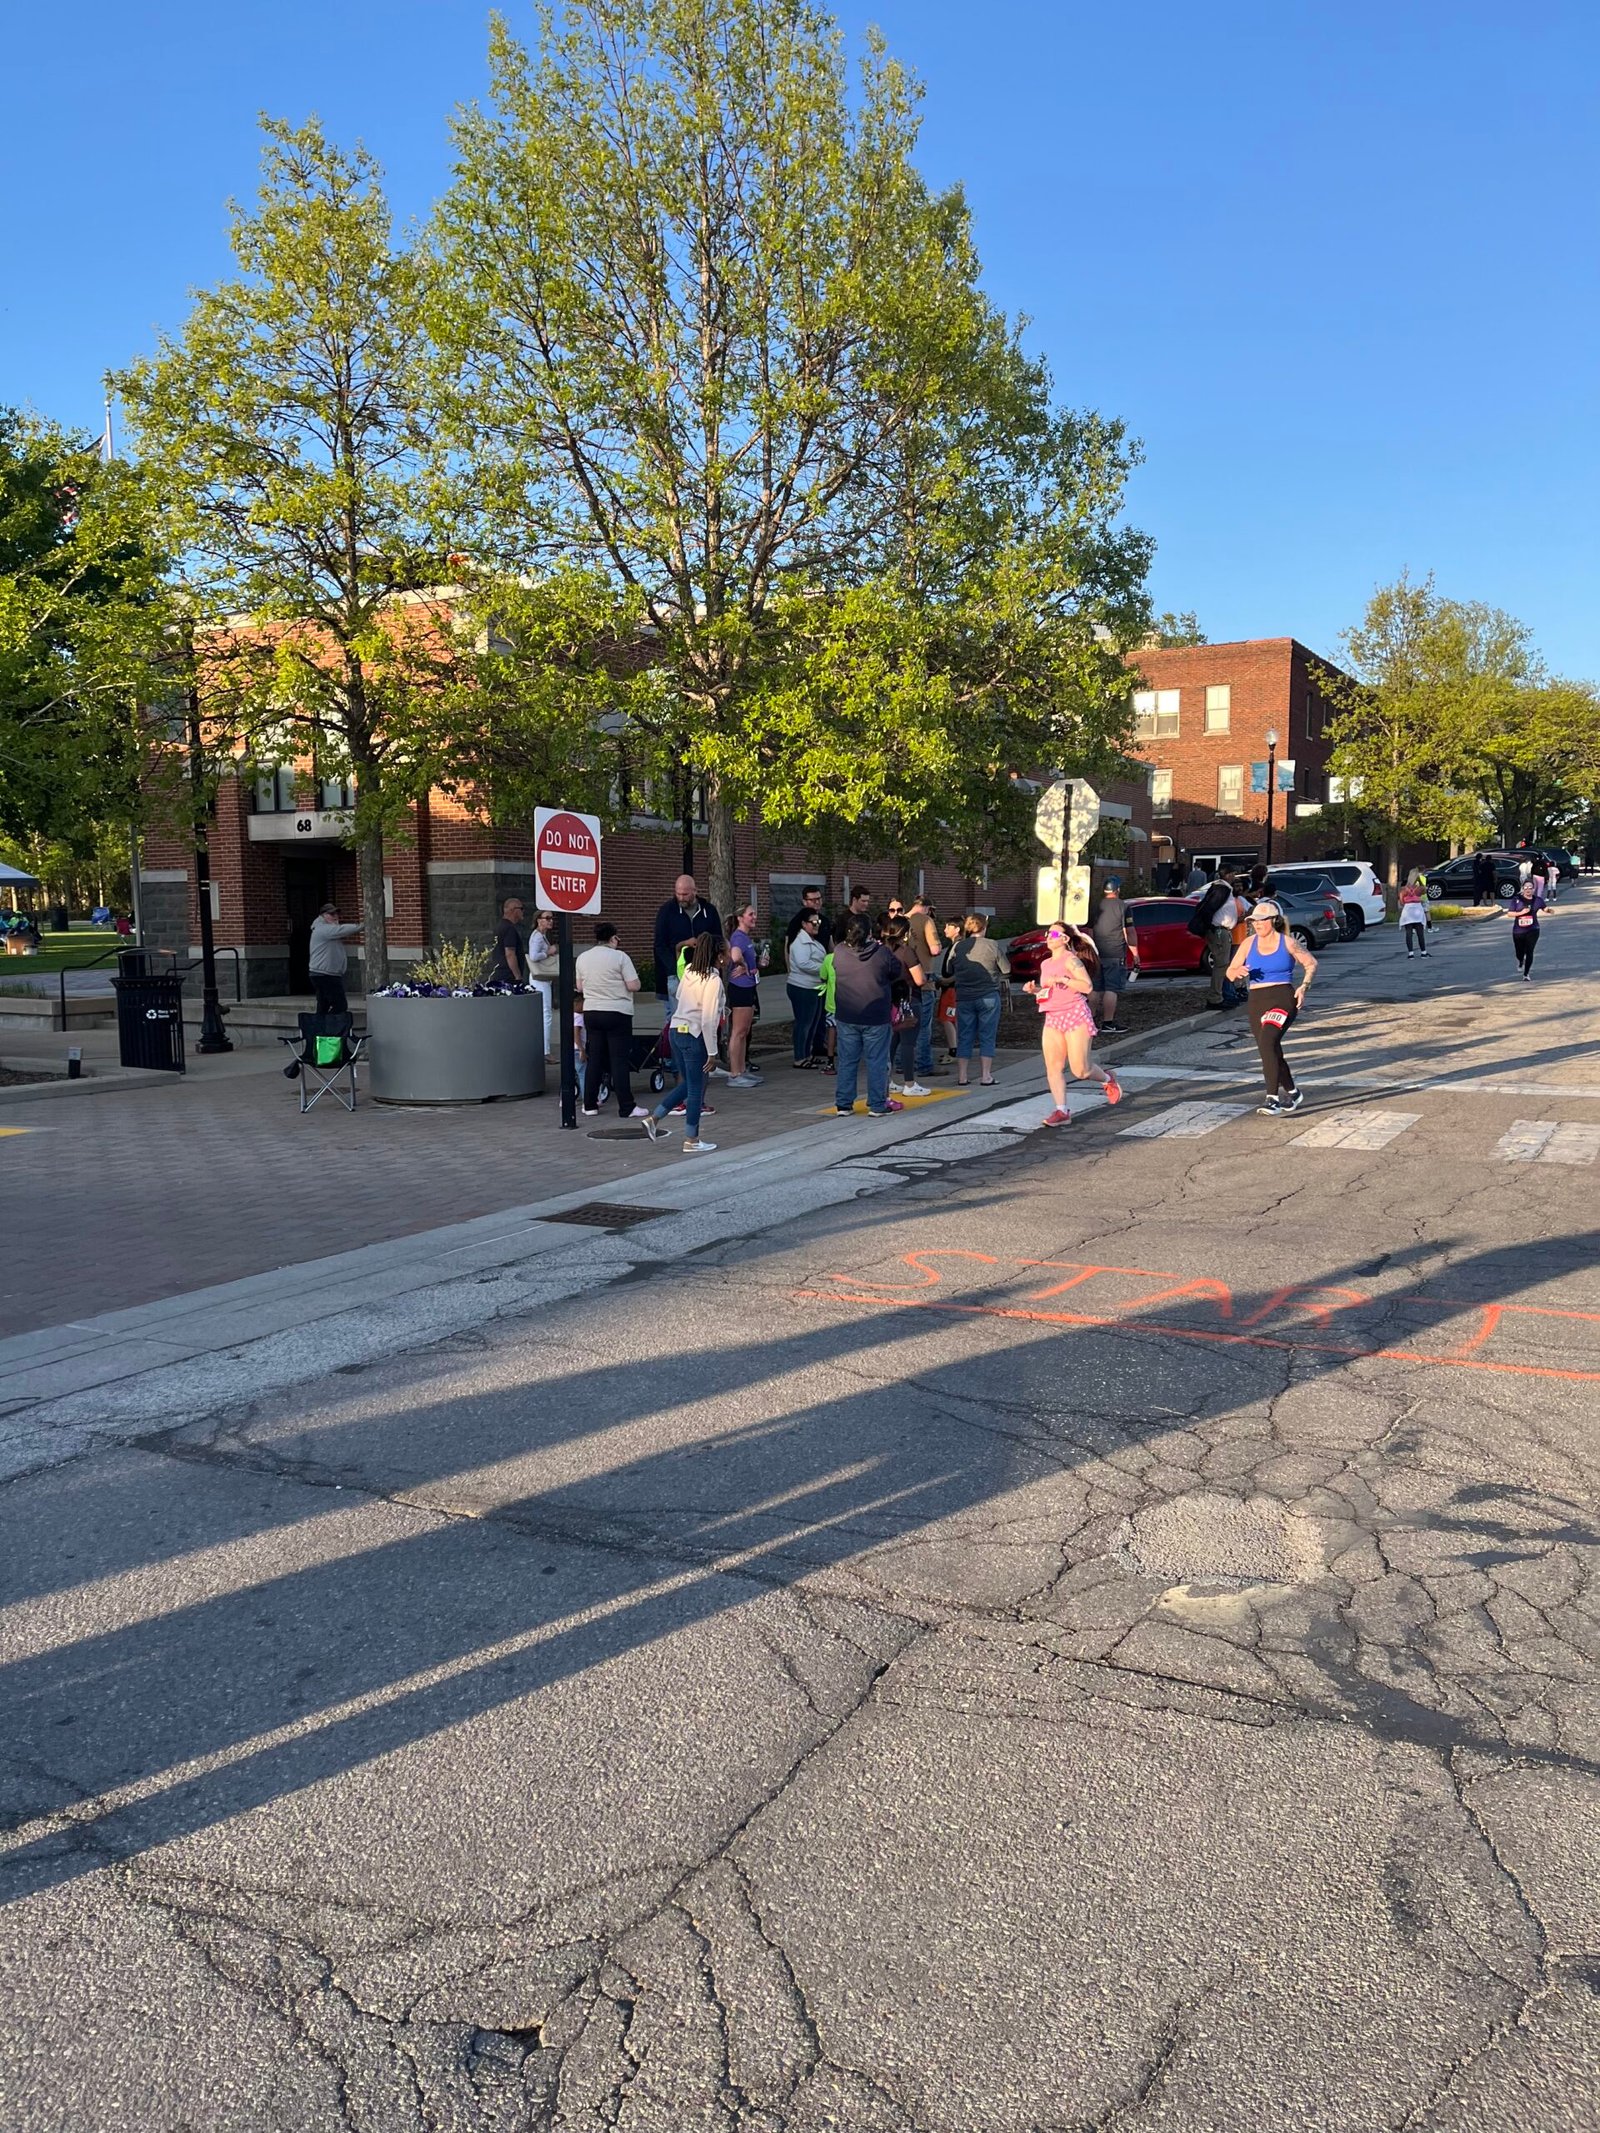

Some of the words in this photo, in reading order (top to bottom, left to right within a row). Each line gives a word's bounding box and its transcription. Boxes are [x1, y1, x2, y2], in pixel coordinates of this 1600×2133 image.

[297, 819, 312, 832] 68
[546, 830, 562, 847] DO
[568, 833, 590, 850] NOT
[551, 875, 587, 893] ENTER
[828, 1249, 1600, 1358] START
